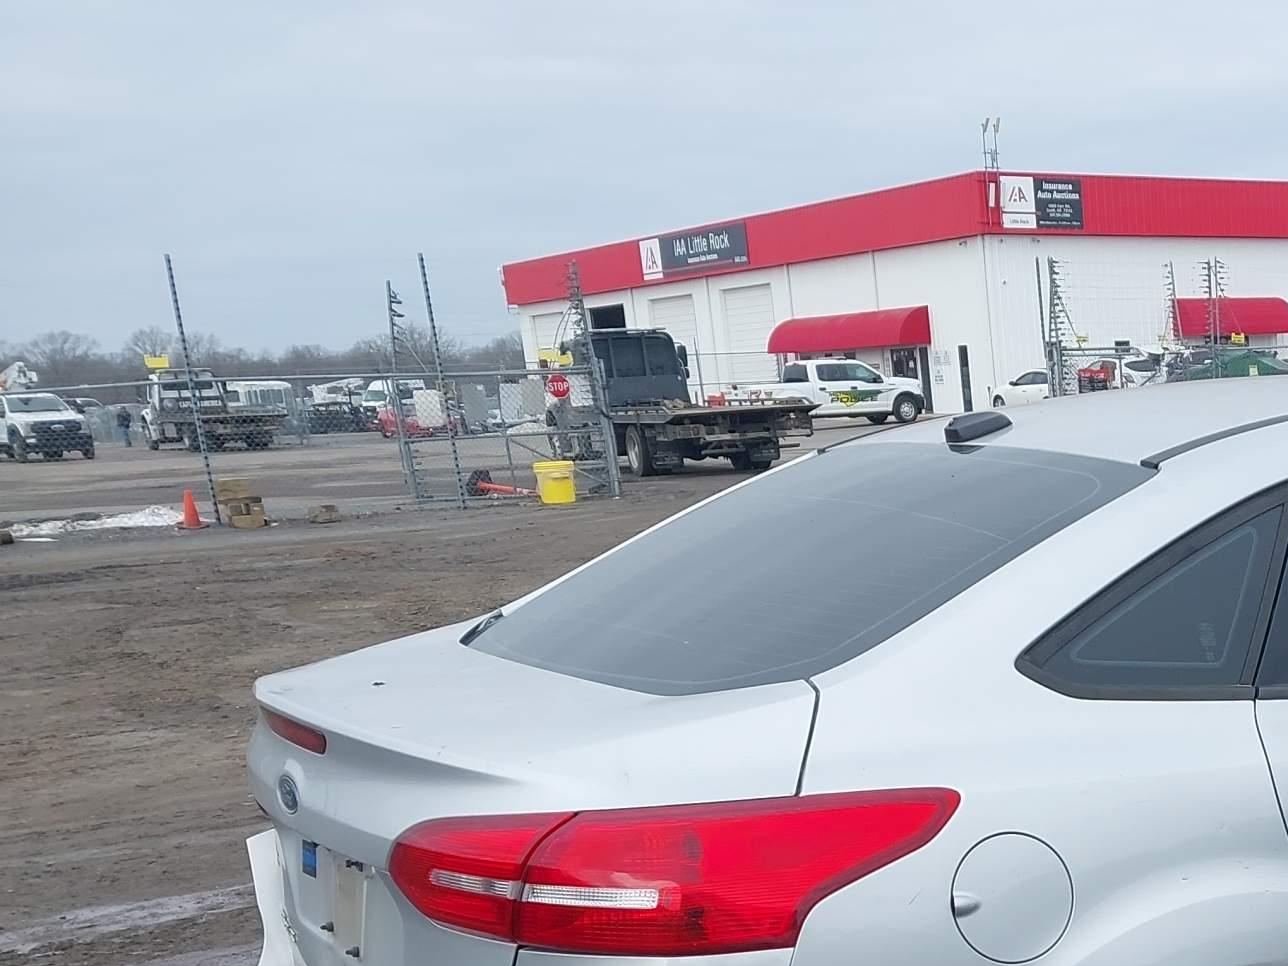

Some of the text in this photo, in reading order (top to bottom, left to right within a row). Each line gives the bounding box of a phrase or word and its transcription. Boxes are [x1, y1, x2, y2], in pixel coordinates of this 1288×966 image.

[1042, 181, 1073, 190] Insurance
[1037, 190, 1052, 199] Auto
[673, 230, 730, 256] IAA Little Rock
[548, 382, 568, 391] STOP
